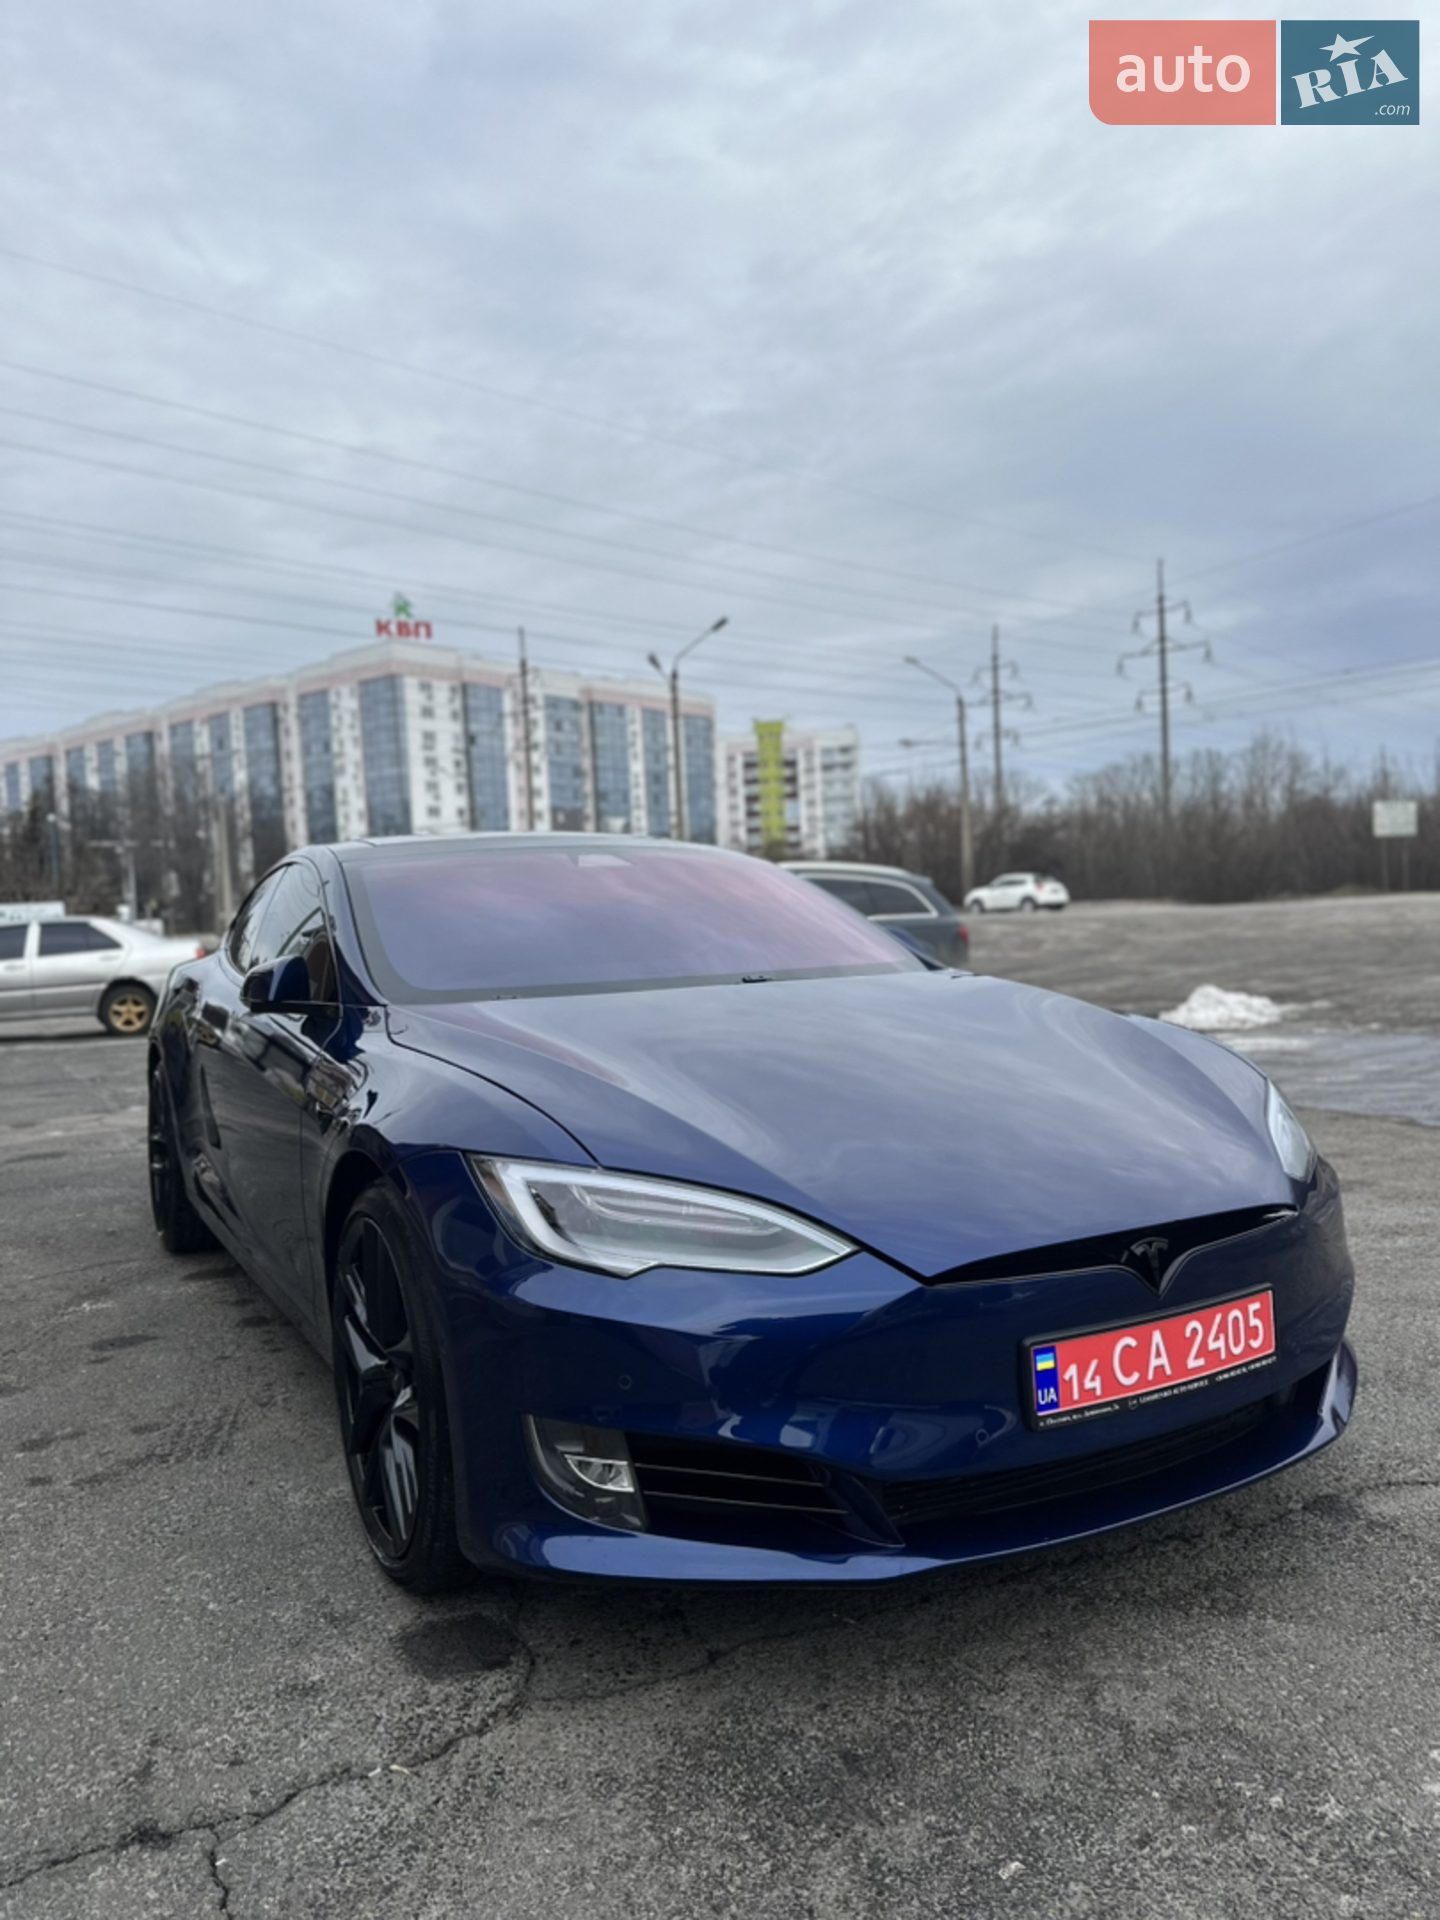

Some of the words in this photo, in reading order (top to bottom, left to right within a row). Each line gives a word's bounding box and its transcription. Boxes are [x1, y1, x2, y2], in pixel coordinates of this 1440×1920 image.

[1063, 1359, 1102, 1401] 14
[1113, 1330, 1173, 1386] CA
[1184, 1302, 1265, 1370] 2405
[1037, 1387, 1058, 1405] UA
